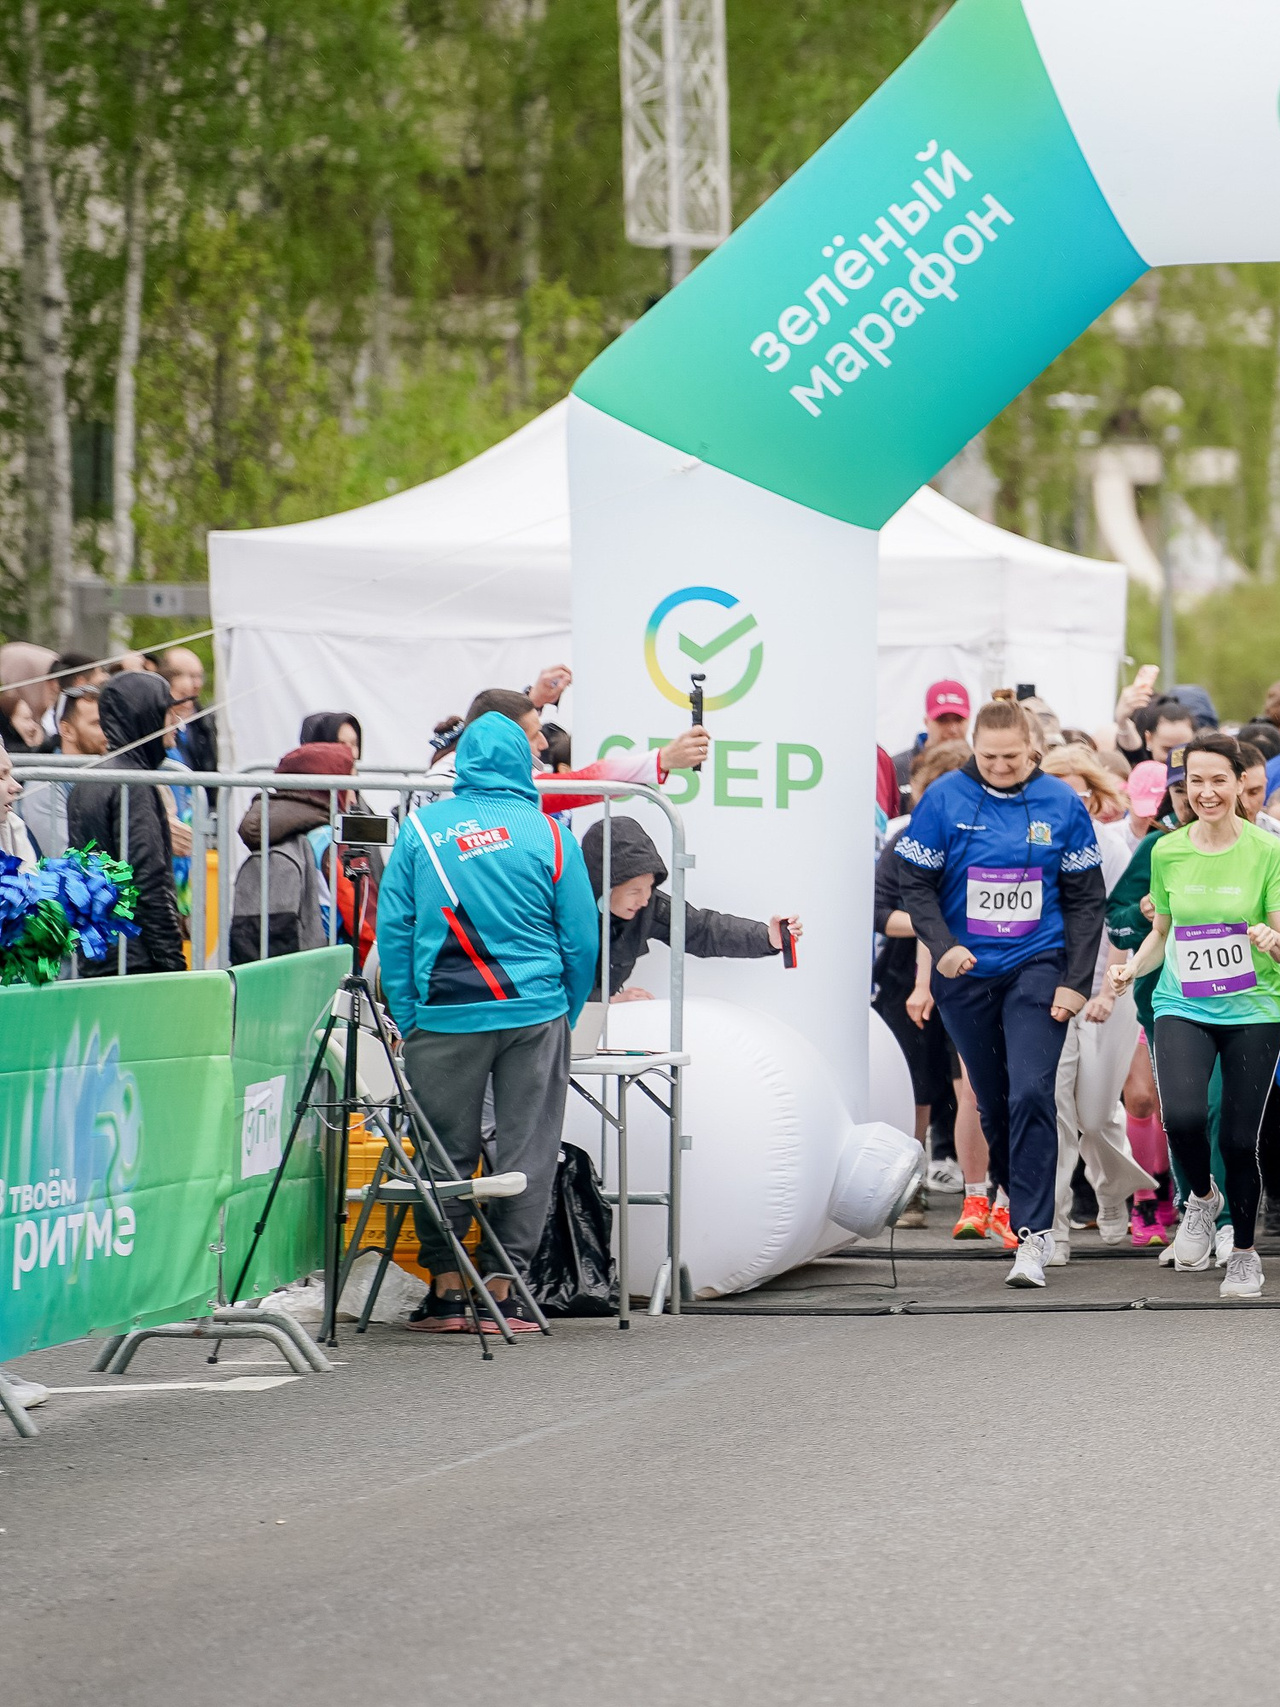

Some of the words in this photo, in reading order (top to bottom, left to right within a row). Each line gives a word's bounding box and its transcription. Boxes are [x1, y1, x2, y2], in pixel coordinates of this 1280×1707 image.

[750, 139, 974, 373] зелёный
[788, 193, 1016, 418] марафон
[431, 819, 482, 847] RACE
[461, 829, 503, 848] TIME
[979, 890, 1032, 910] 2000
[1187, 944, 1244, 971] 2100
[9, 1168, 77, 1213] твоём
[12, 1205, 136, 1291] ритме
